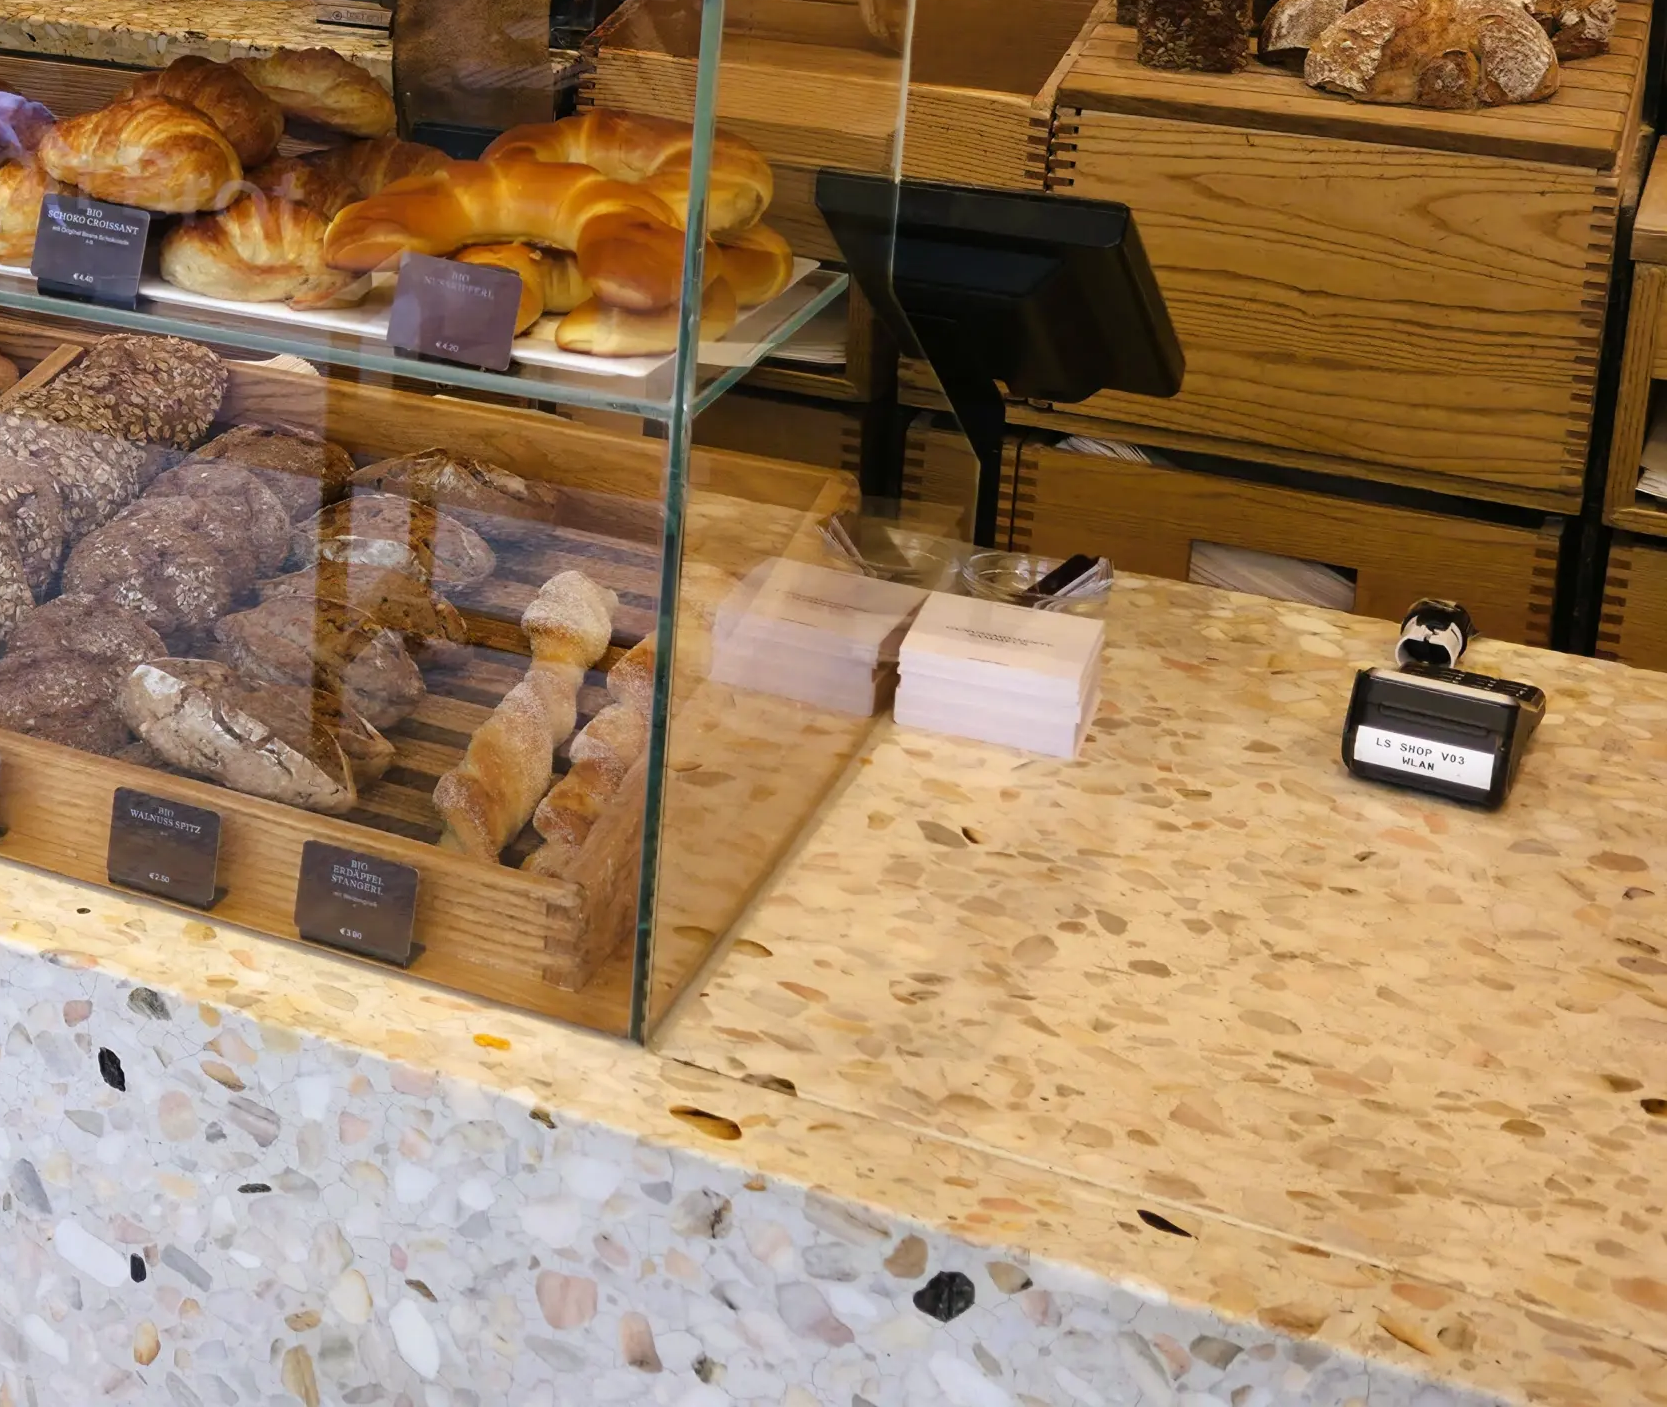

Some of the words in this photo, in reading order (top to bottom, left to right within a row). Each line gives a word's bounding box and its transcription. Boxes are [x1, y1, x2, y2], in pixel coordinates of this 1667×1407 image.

[47, 209, 86, 224] SCHOKO
[87, 218, 140, 235] CROISSANT
[87, 208, 103, 218] BIO
[1376, 737, 1392, 749] LS
[1399, 742, 1433, 758] SHOP
[1441, 752, 1466, 766] V03
[1402, 756, 1436, 772] WLAN
[130, 808, 174, 827] WALNUSS
[175, 820, 202, 835] SPITZ
[158, 806, 175, 817] BIO
[333, 864, 385, 886] ERDÄPFEL
[351, 859, 369, 871] BIO
[331, 874, 384, 896] STANGERL
